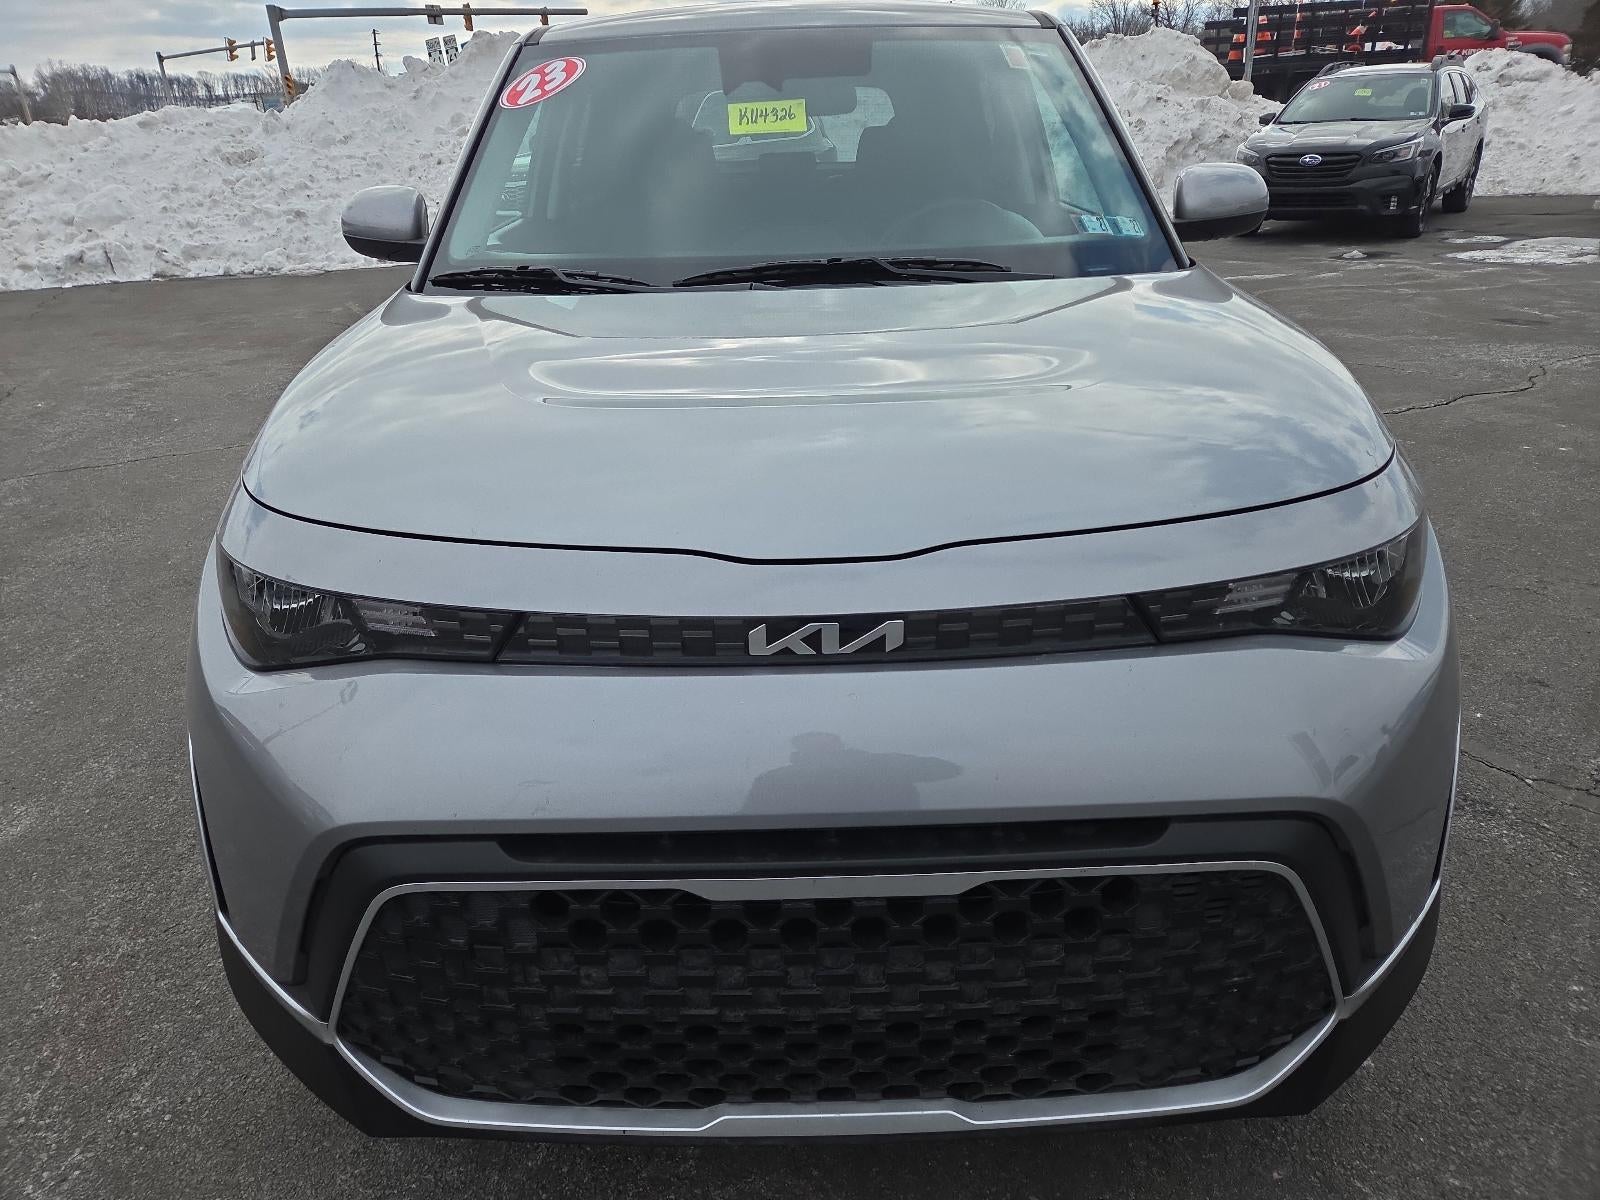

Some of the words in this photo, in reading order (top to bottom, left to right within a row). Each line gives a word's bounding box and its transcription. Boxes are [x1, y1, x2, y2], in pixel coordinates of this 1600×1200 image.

[516, 60, 567, 105] 23
[738, 104, 797, 126] KU4326
[748, 619, 905, 656] KIA
